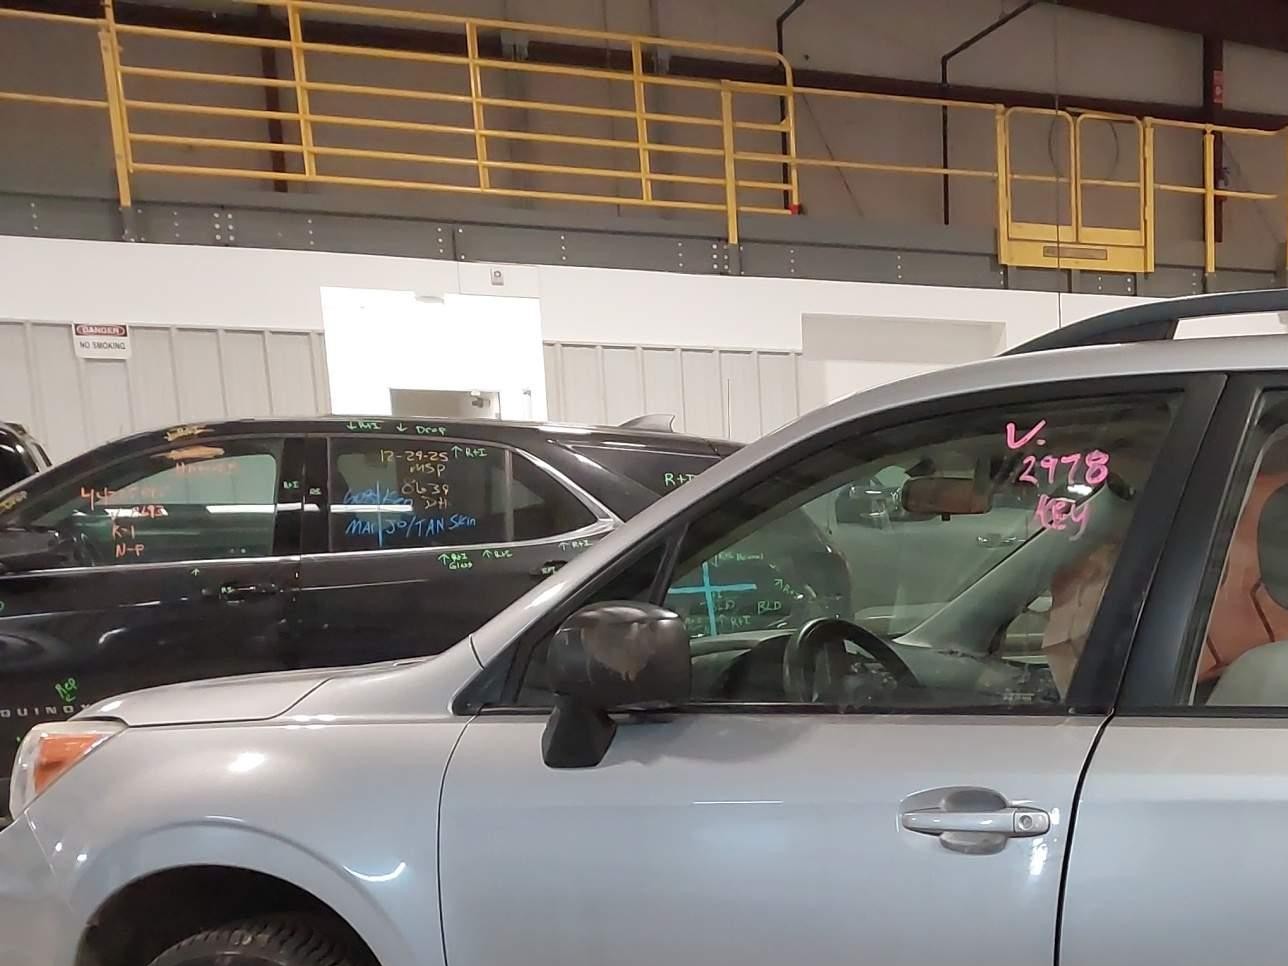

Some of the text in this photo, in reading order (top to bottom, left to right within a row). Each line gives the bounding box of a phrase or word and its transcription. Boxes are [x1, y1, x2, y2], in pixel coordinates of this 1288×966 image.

[82, 325, 120, 335] DANGER
[80, 341, 126, 350] NO SMOKING
[415, 425, 447, 436] Drop
[1019, 449, 1110, 485] 2978
[0, 703, 91, 718] QUINO
